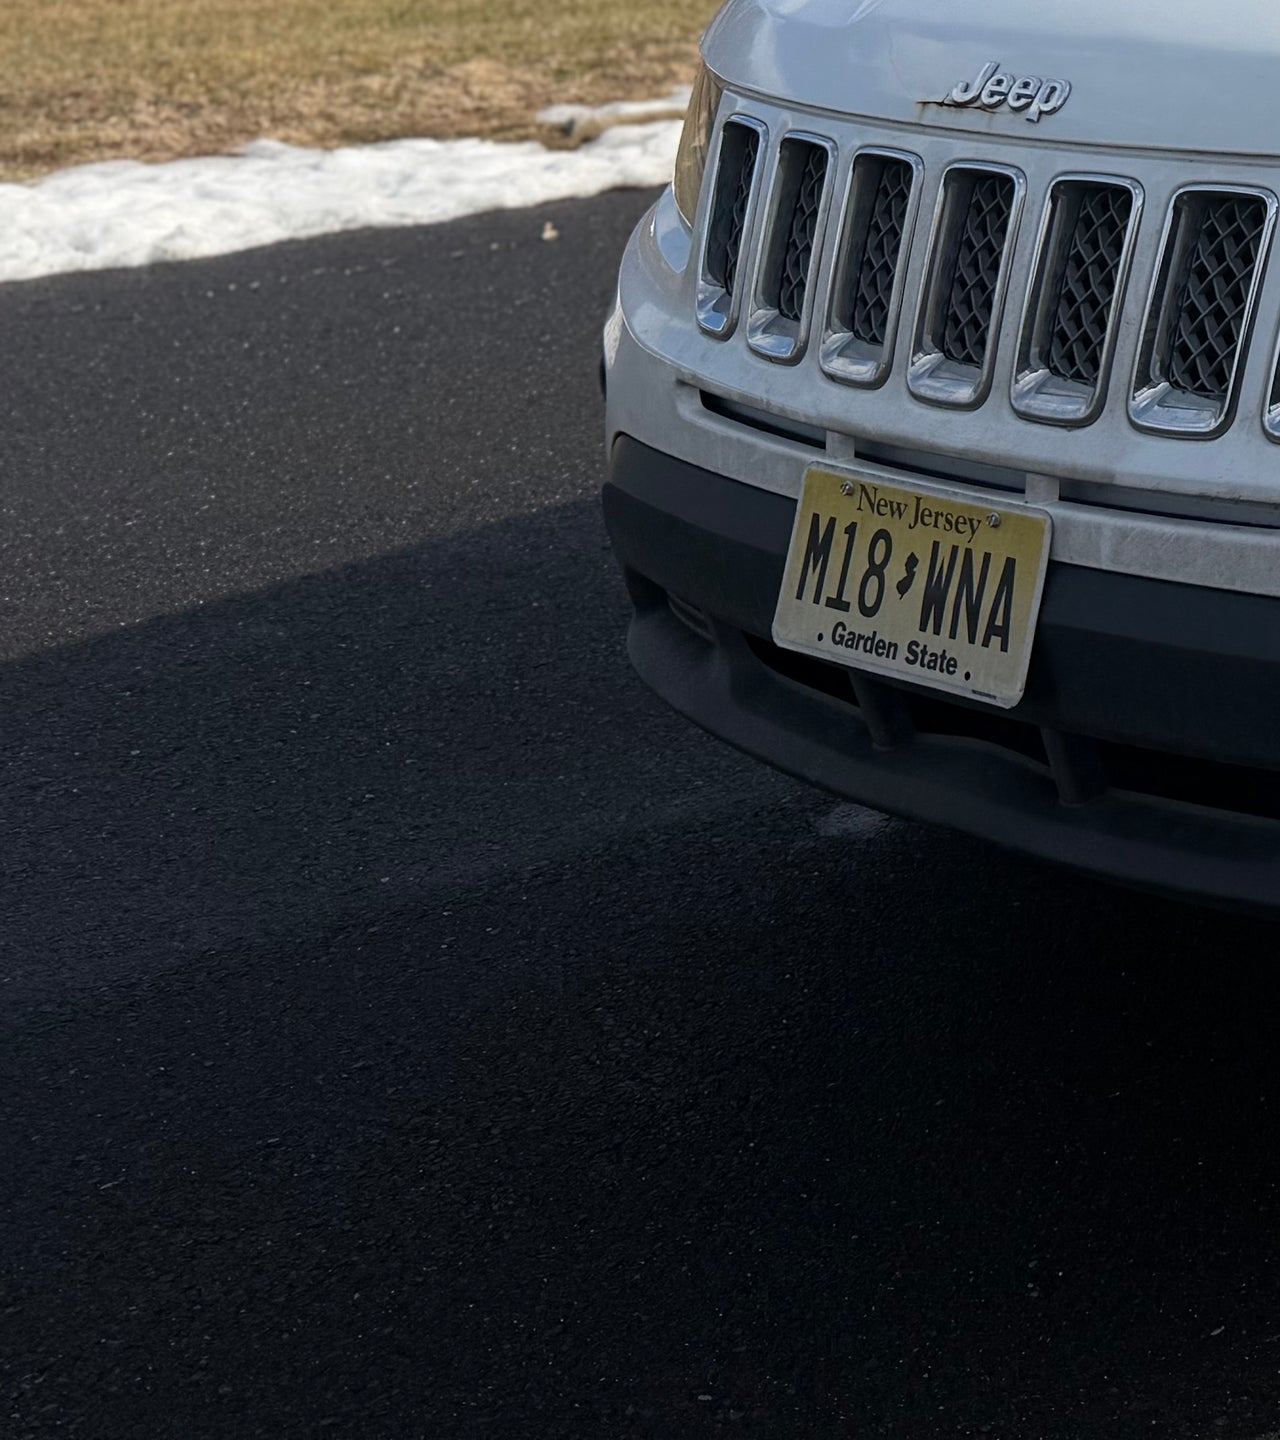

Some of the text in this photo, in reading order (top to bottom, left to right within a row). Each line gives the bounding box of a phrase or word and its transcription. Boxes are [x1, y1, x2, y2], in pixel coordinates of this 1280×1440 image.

[952, 62, 1072, 123] Jeep
[856, 483, 982, 543] New Jersey
[796, 512, 1017, 652] M18 WNA
[831, 621, 958, 675] Garden State
